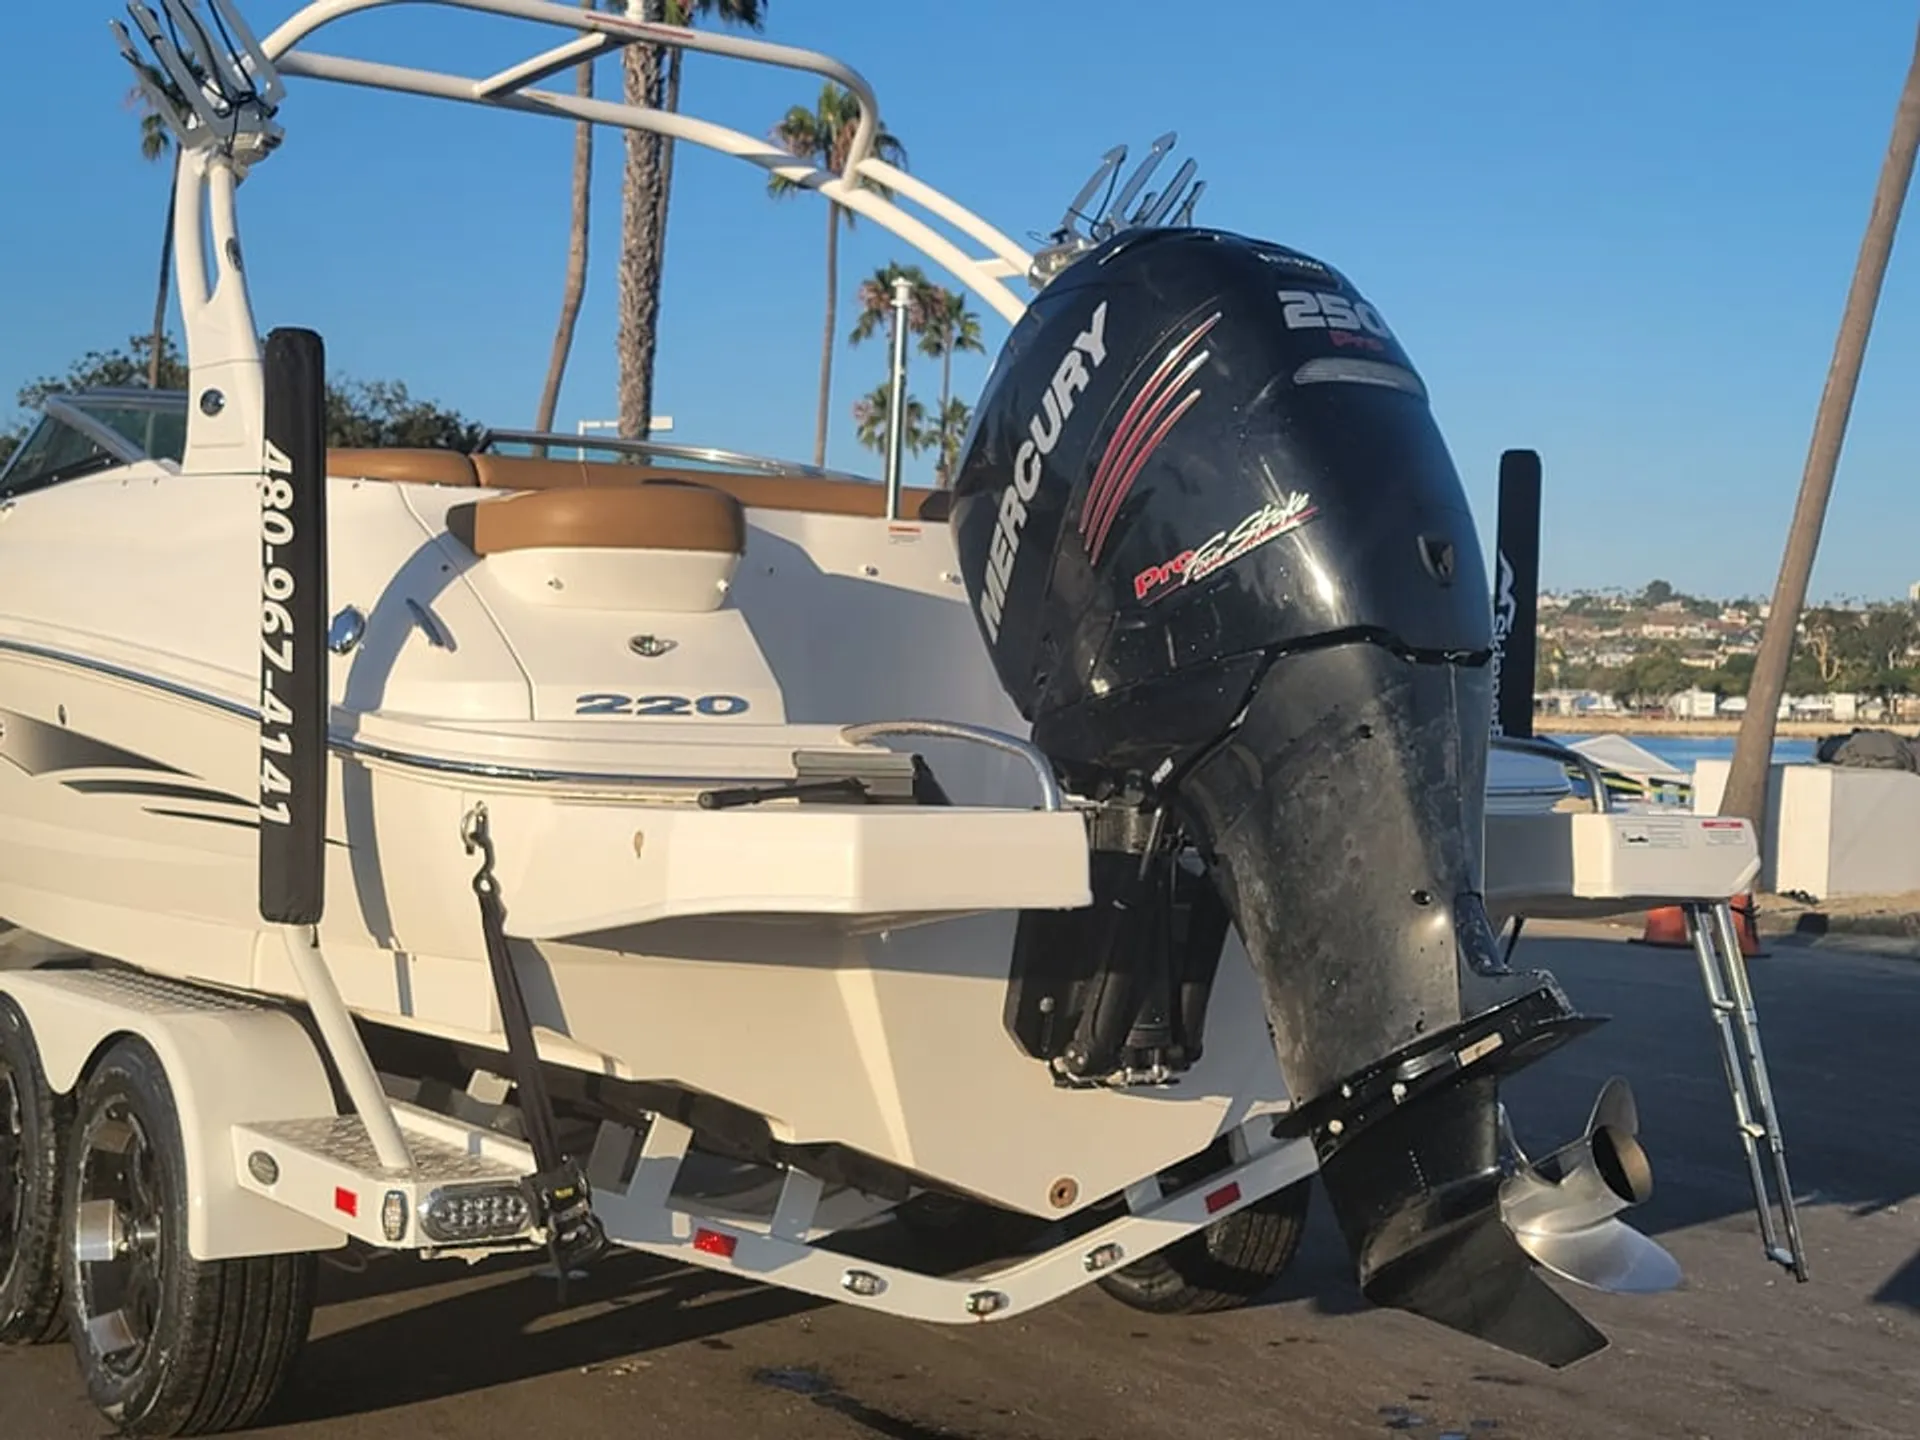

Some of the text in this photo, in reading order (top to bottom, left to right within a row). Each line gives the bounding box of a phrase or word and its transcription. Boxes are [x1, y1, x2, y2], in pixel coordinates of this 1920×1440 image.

[1277, 289, 1391, 340] 250
[980, 301, 1107, 645] MERCURY
[1134, 550, 1196, 600] Pro
[259, 438, 295, 825] 480-967-4141
[575, 693, 749, 716] 220
